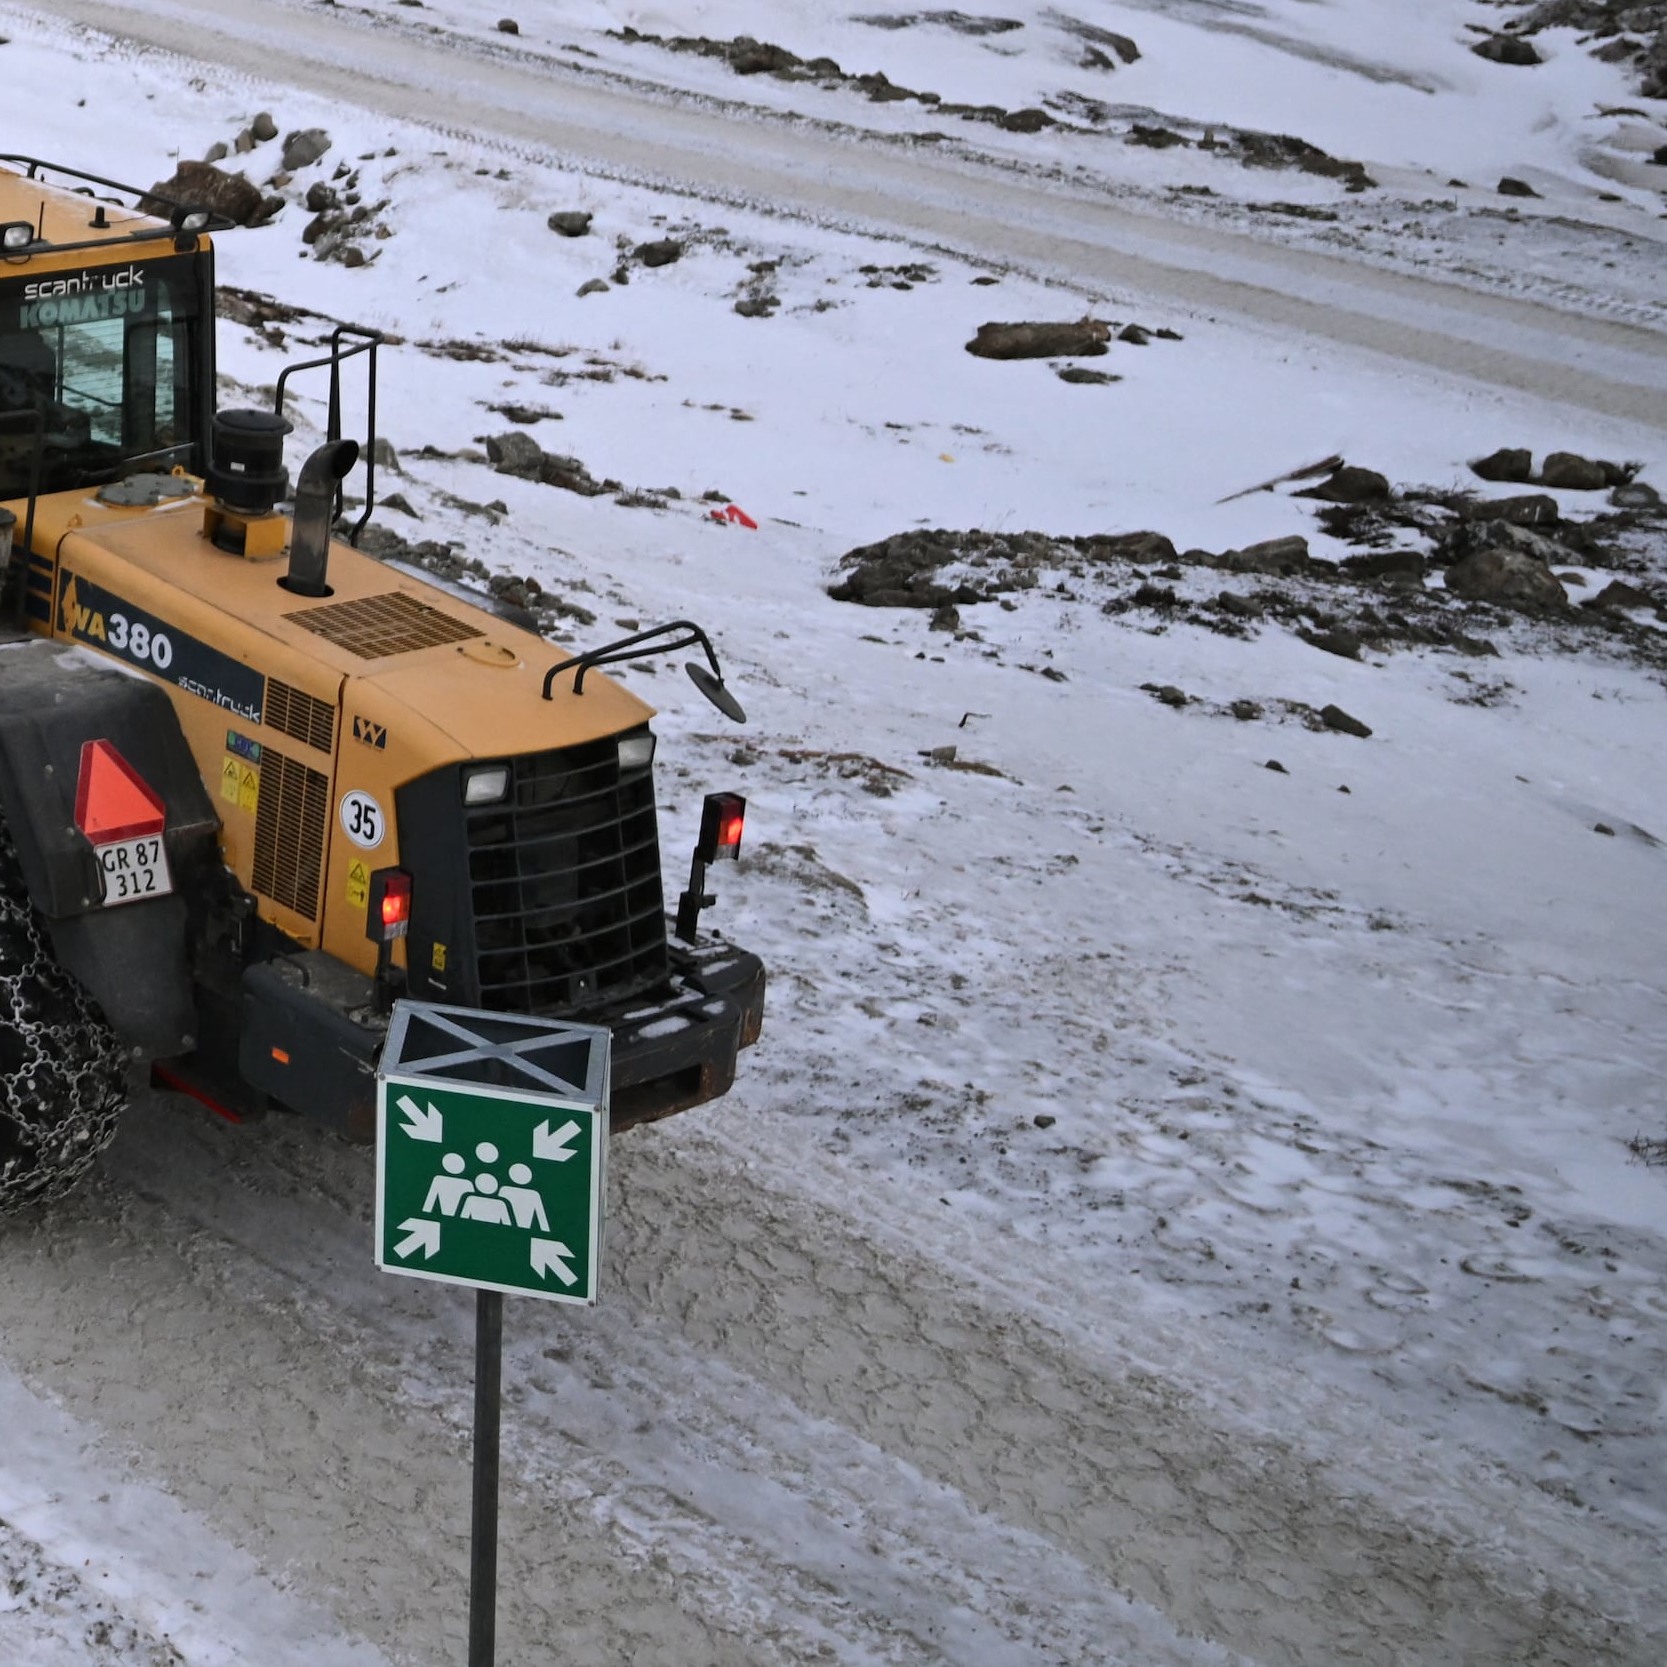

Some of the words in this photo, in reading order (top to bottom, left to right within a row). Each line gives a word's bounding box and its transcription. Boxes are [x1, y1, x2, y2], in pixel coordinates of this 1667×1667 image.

[20, 288, 145, 329] KOMATSU
[349, 799, 376, 840] 35
[102, 847, 130, 872] GR
[135, 840, 159, 866] 87
[116, 868, 156, 897] 312
